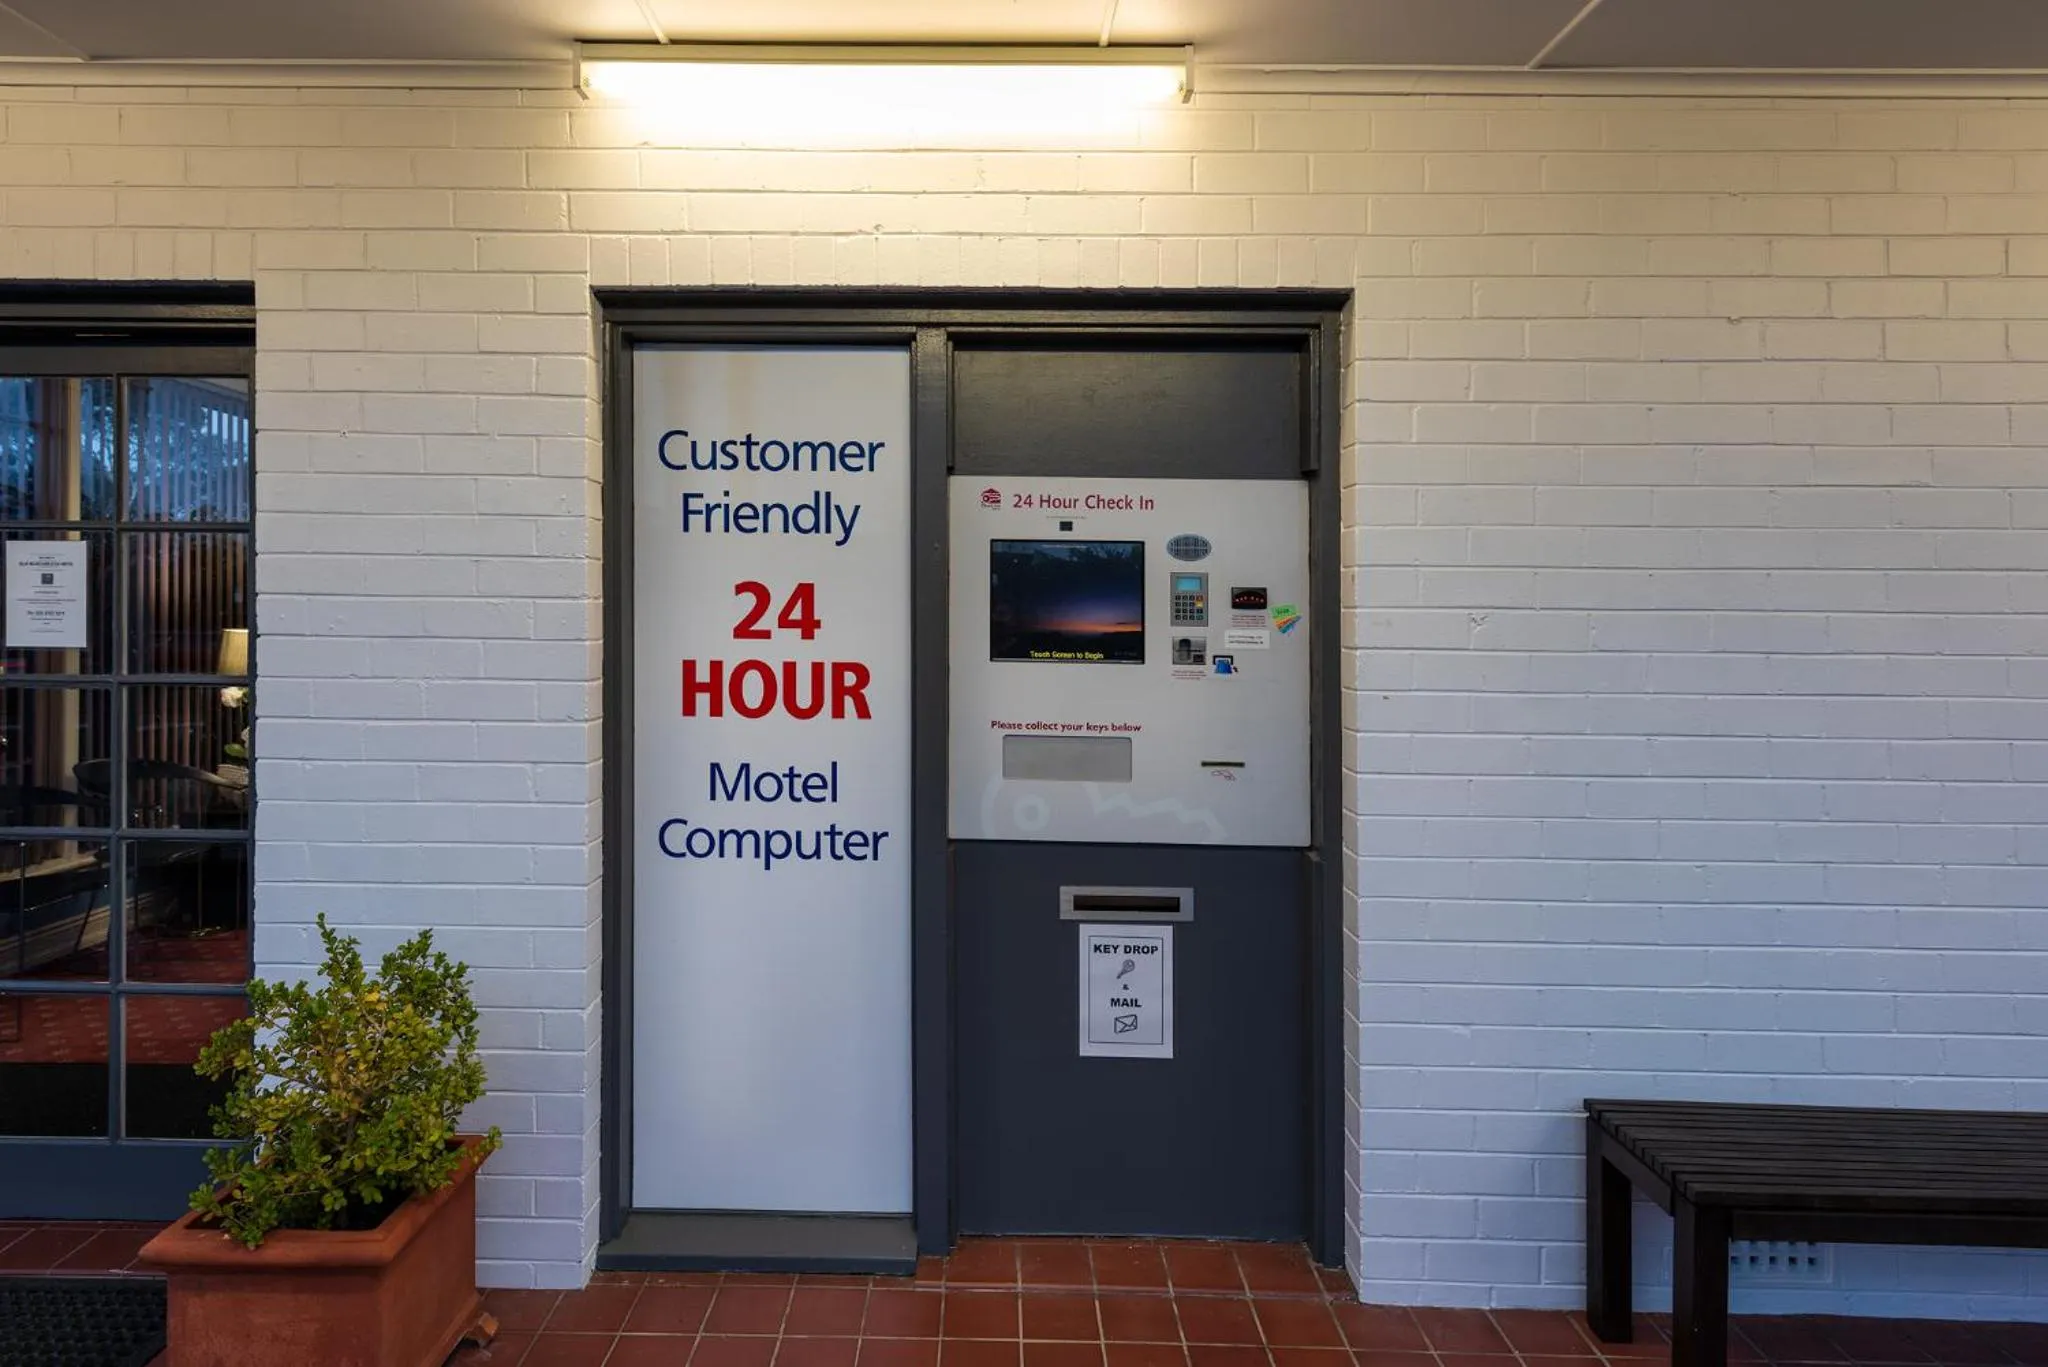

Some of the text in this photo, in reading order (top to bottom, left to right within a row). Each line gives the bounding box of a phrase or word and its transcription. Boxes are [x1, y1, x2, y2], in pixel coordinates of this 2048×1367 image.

[658, 430, 885, 472] Customer
[682, 490, 861, 547] Friendly
[1013, 494, 1033, 508] 24
[1039, 495, 1079, 509] Hour
[1085, 495, 1132, 510] Check
[1140, 496, 1154, 510] In
[732, 580, 821, 640] 24
[1052, 651, 1075, 659] Screen
[1085, 652, 1104, 660] Begin
[681, 659, 872, 720] HOUR
[991, 720, 1142, 733] Please collect your keys below
[709, 761, 838, 803] Motel
[658, 818, 889, 870] Computer
[1093, 944, 1159, 955] KEY DROP
[1110, 998, 1142, 1008] MAIL
